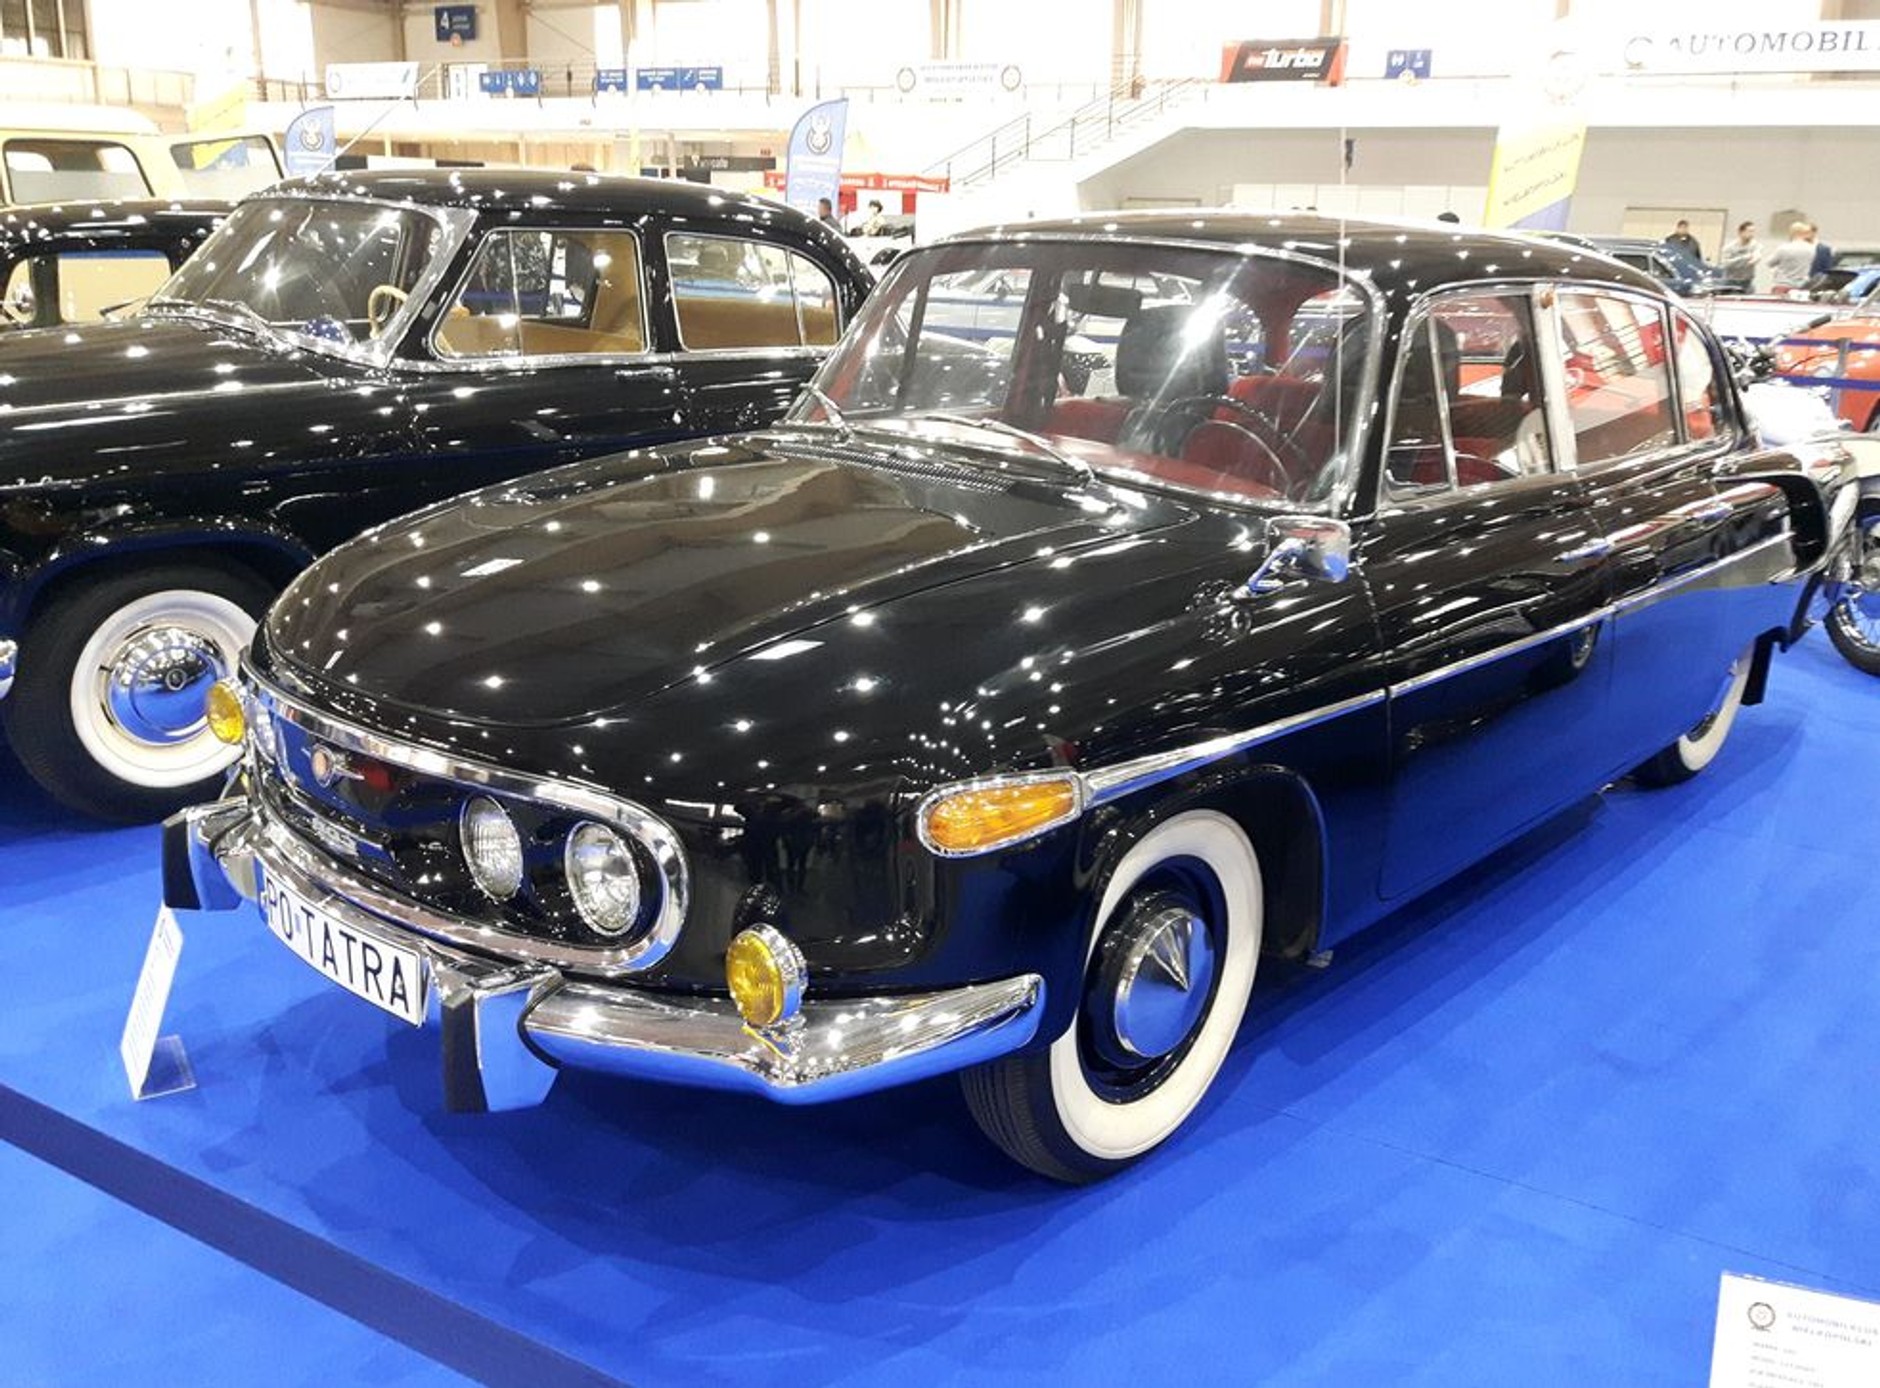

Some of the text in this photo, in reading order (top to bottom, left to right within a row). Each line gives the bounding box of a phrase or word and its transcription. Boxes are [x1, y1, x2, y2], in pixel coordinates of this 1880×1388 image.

[440, 11, 449, 29] 4
[1669, 30, 1880, 55] AUTOMOBIL
[266, 878, 410, 1014] PO TATRA
